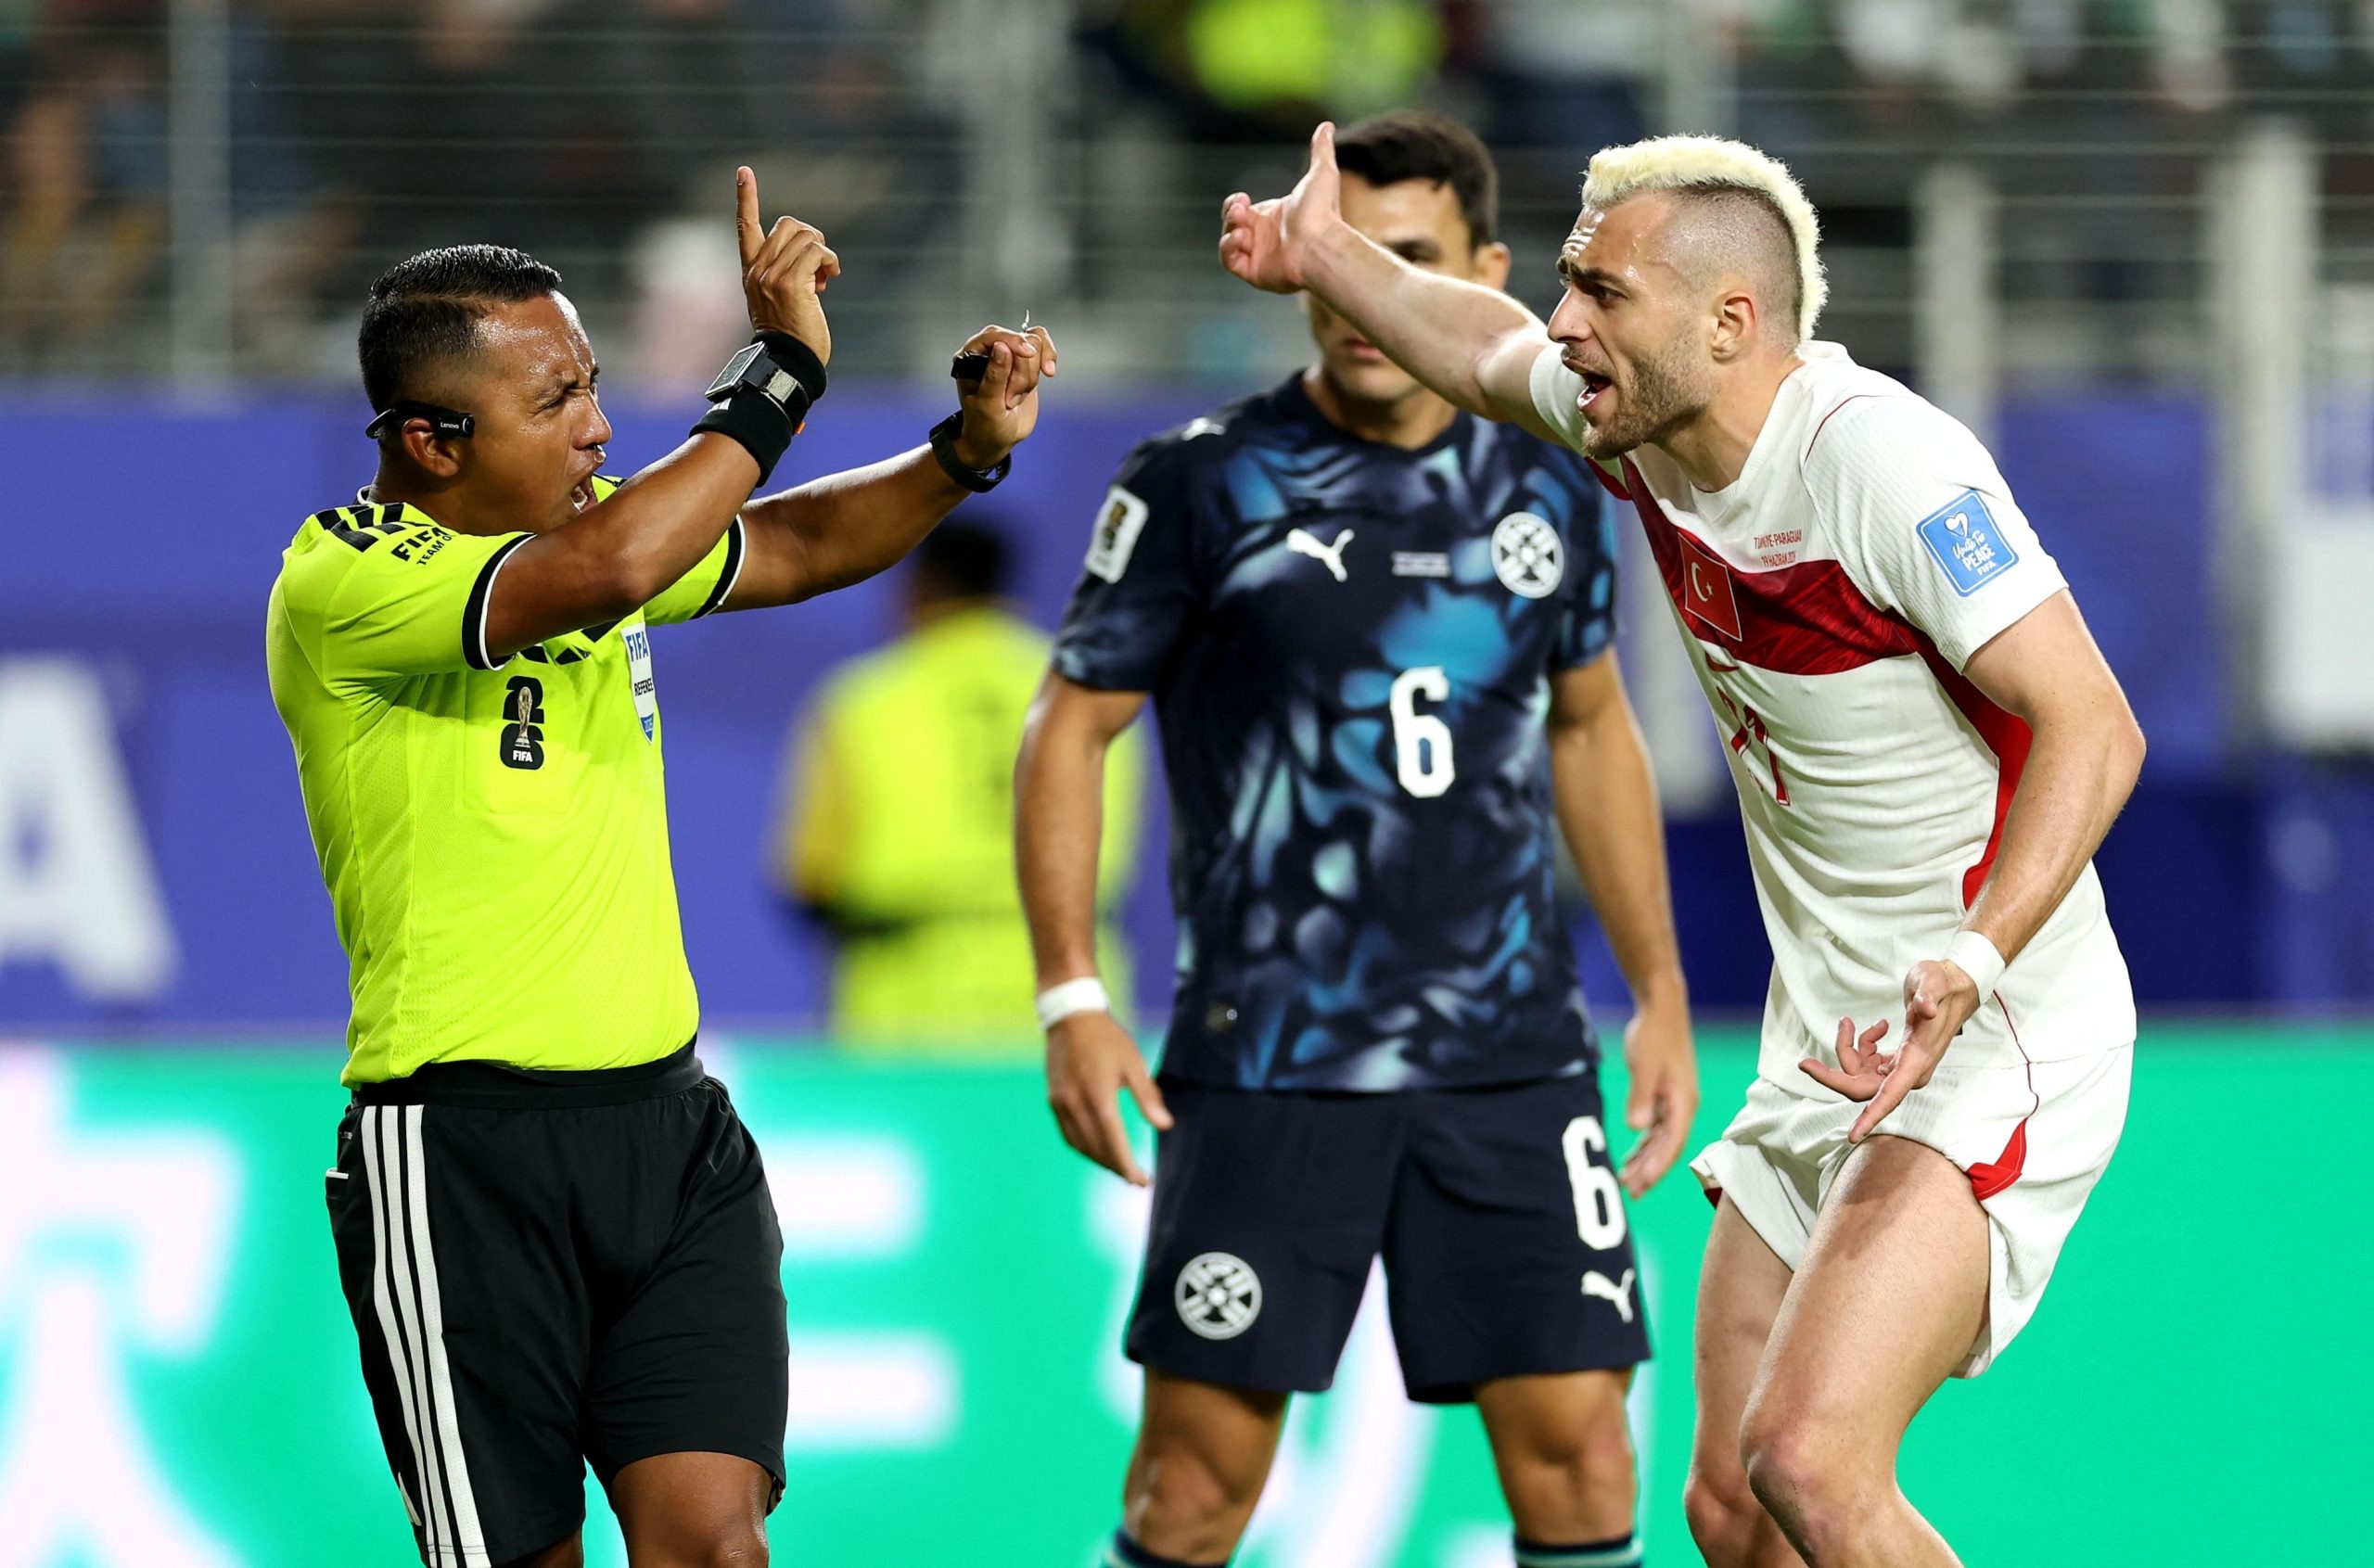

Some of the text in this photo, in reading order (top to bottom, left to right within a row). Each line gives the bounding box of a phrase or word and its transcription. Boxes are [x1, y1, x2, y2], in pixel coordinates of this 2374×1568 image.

[440, 421, 460, 429] Lenovo
[390, 527, 450, 562] FIFA
[416, 540, 445, 565] TEAM
[1961, 543, 1997, 571] PEACE
[1976, 560, 1997, 576] FIFA
[625, 631, 649, 662] FIFA
[633, 677, 654, 697] REFEREE
[1390, 666, 1456, 798] 6
[512, 749, 534, 763] FIFA
[1562, 1115, 1627, 1250] 6
